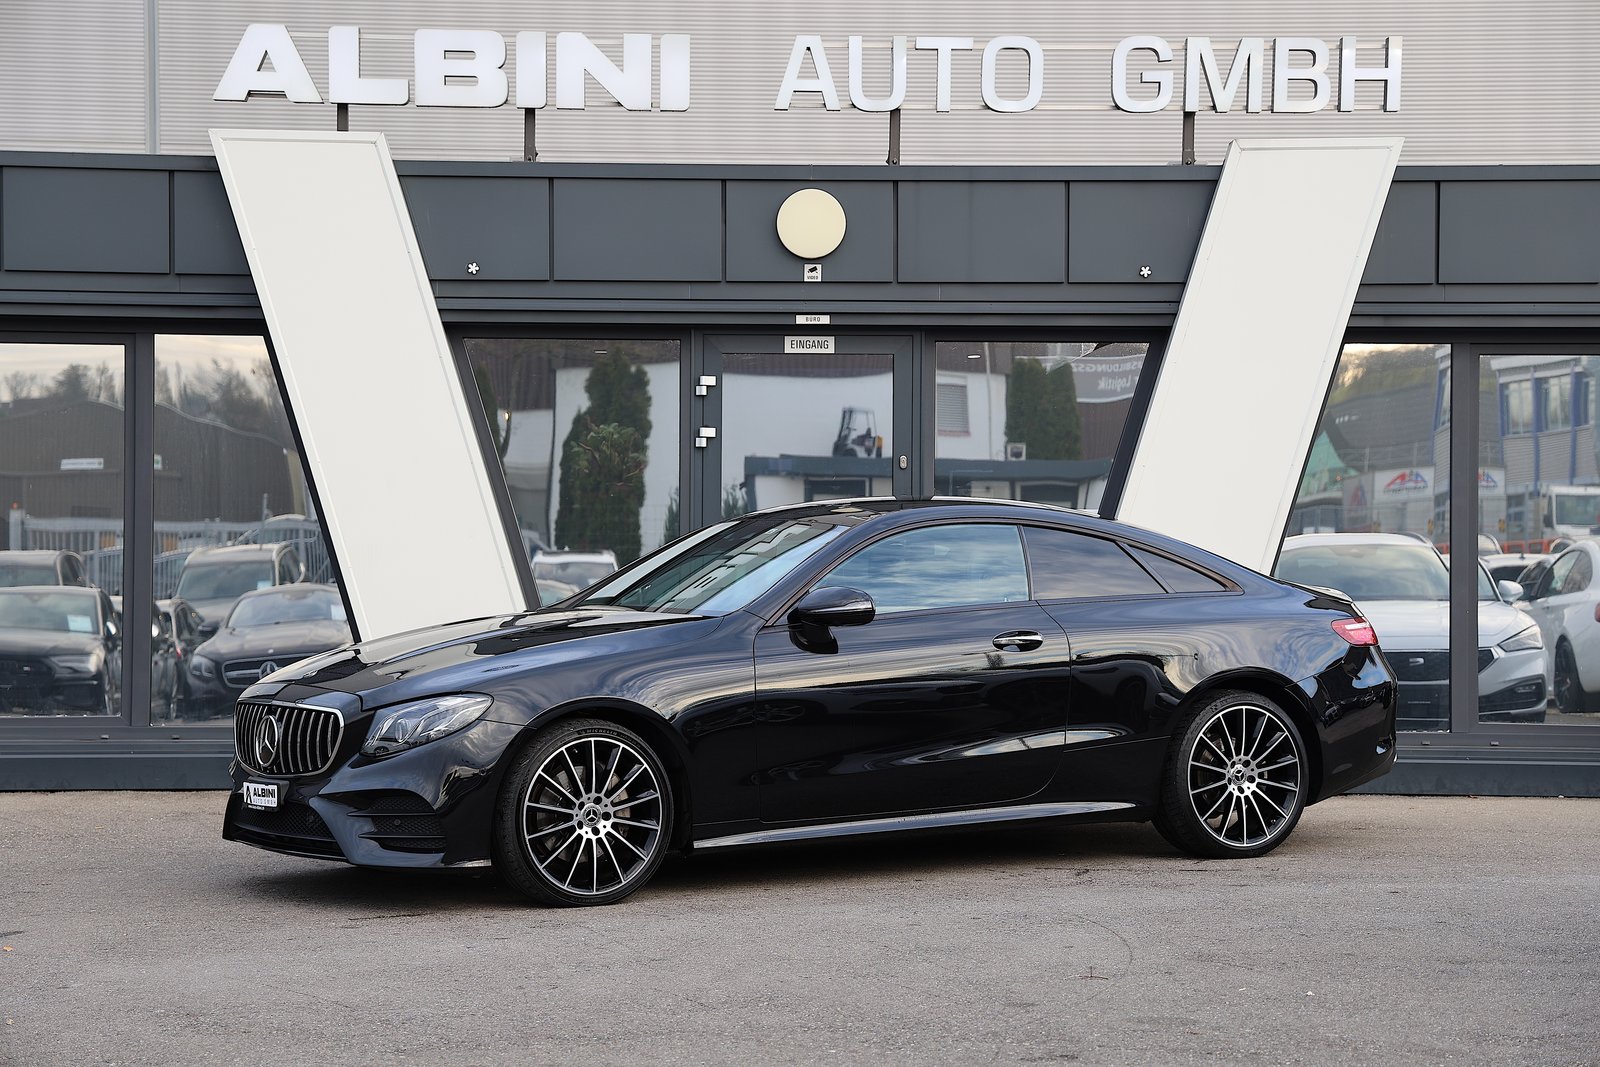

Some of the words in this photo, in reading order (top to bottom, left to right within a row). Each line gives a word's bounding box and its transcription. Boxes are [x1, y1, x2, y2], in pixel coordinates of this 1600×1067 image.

[212, 23, 691, 112] ALBINI
[774, 35, 1044, 113] AUTO
[1110, 35, 1404, 113] GMBH
[805, 315, 821, 323] BÜRO
[790, 339, 829, 350] EINGANG
[253, 787, 276, 798] ALBINI
